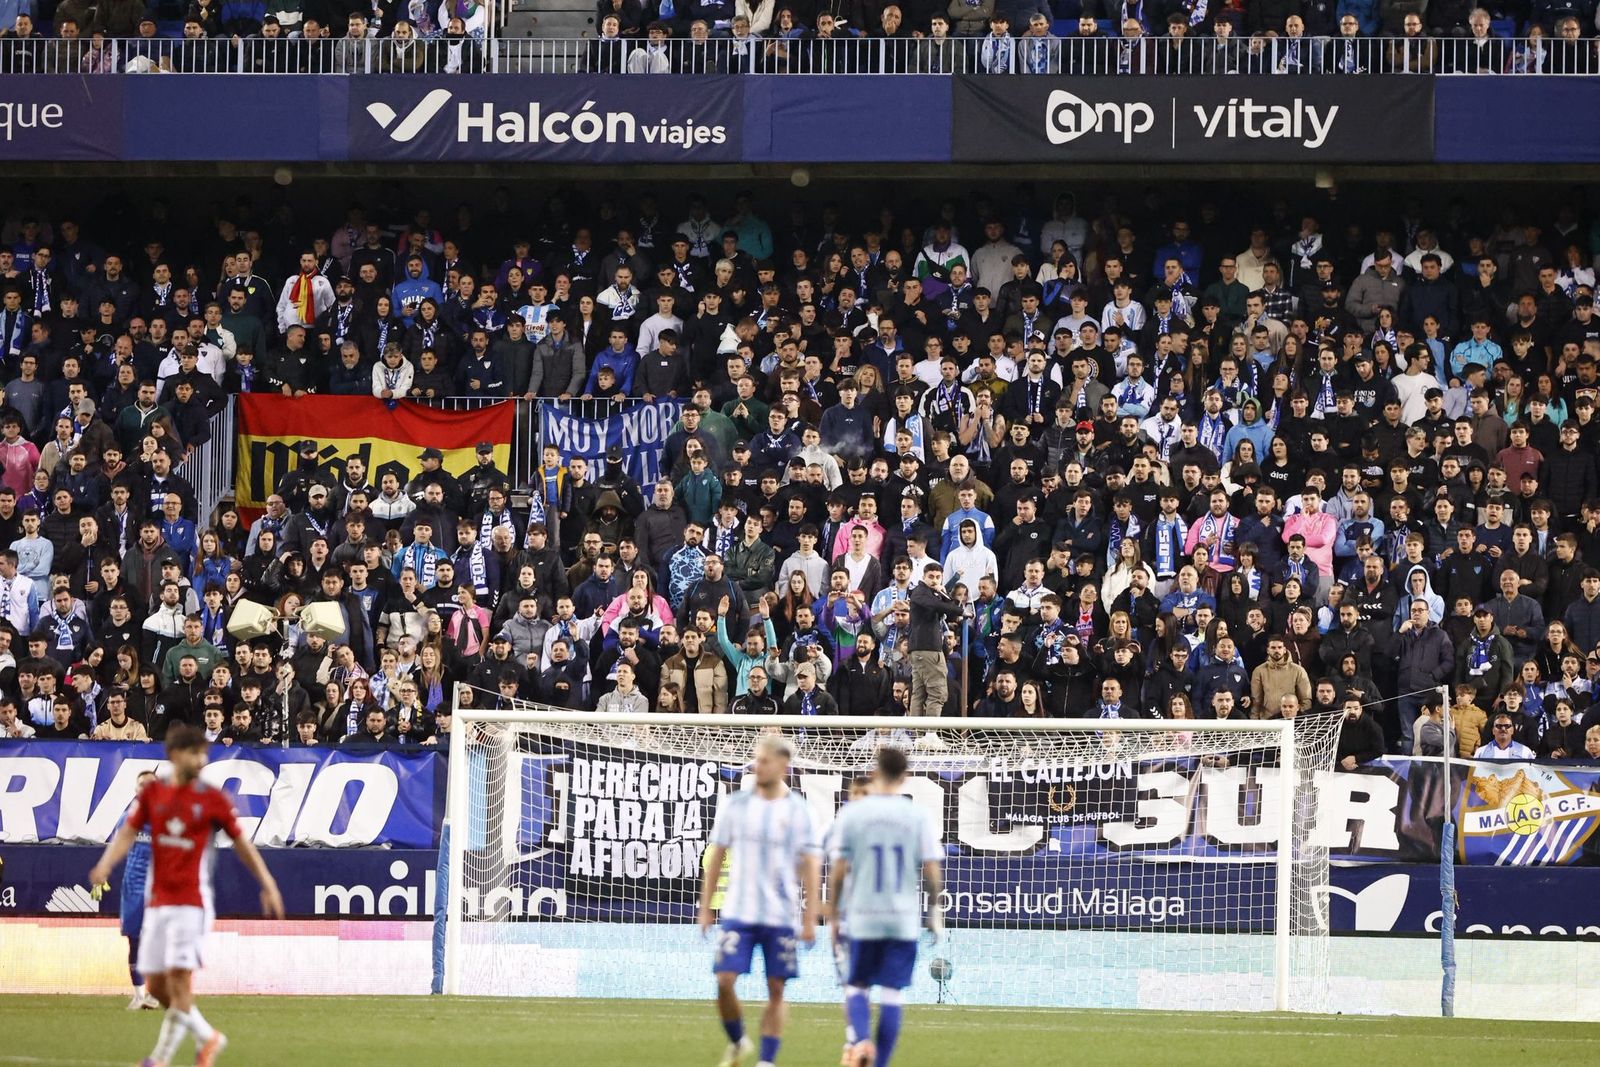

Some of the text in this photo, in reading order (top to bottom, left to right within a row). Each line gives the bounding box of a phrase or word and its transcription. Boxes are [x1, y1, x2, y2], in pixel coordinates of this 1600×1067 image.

[457, 100, 727, 149] Halcón viajes
[1193, 98, 1340, 148] vítaly
[547, 410, 609, 453] MUY
[1158, 530, 1170, 569] LOS
[572, 758, 717, 801] DERECHOS
[989, 758, 1013, 782] EL
[573, 797, 666, 841] PARA
[674, 801, 702, 840] LA
[1047, 815, 1070, 823] CLUB
[1073, 813, 1084, 822] DE
[1558, 797, 1591, 813] C.F.
[570, 837, 706, 880] AFICIÓN
[871, 843, 906, 893] 11
[1072, 888, 1185, 922] Málaga
